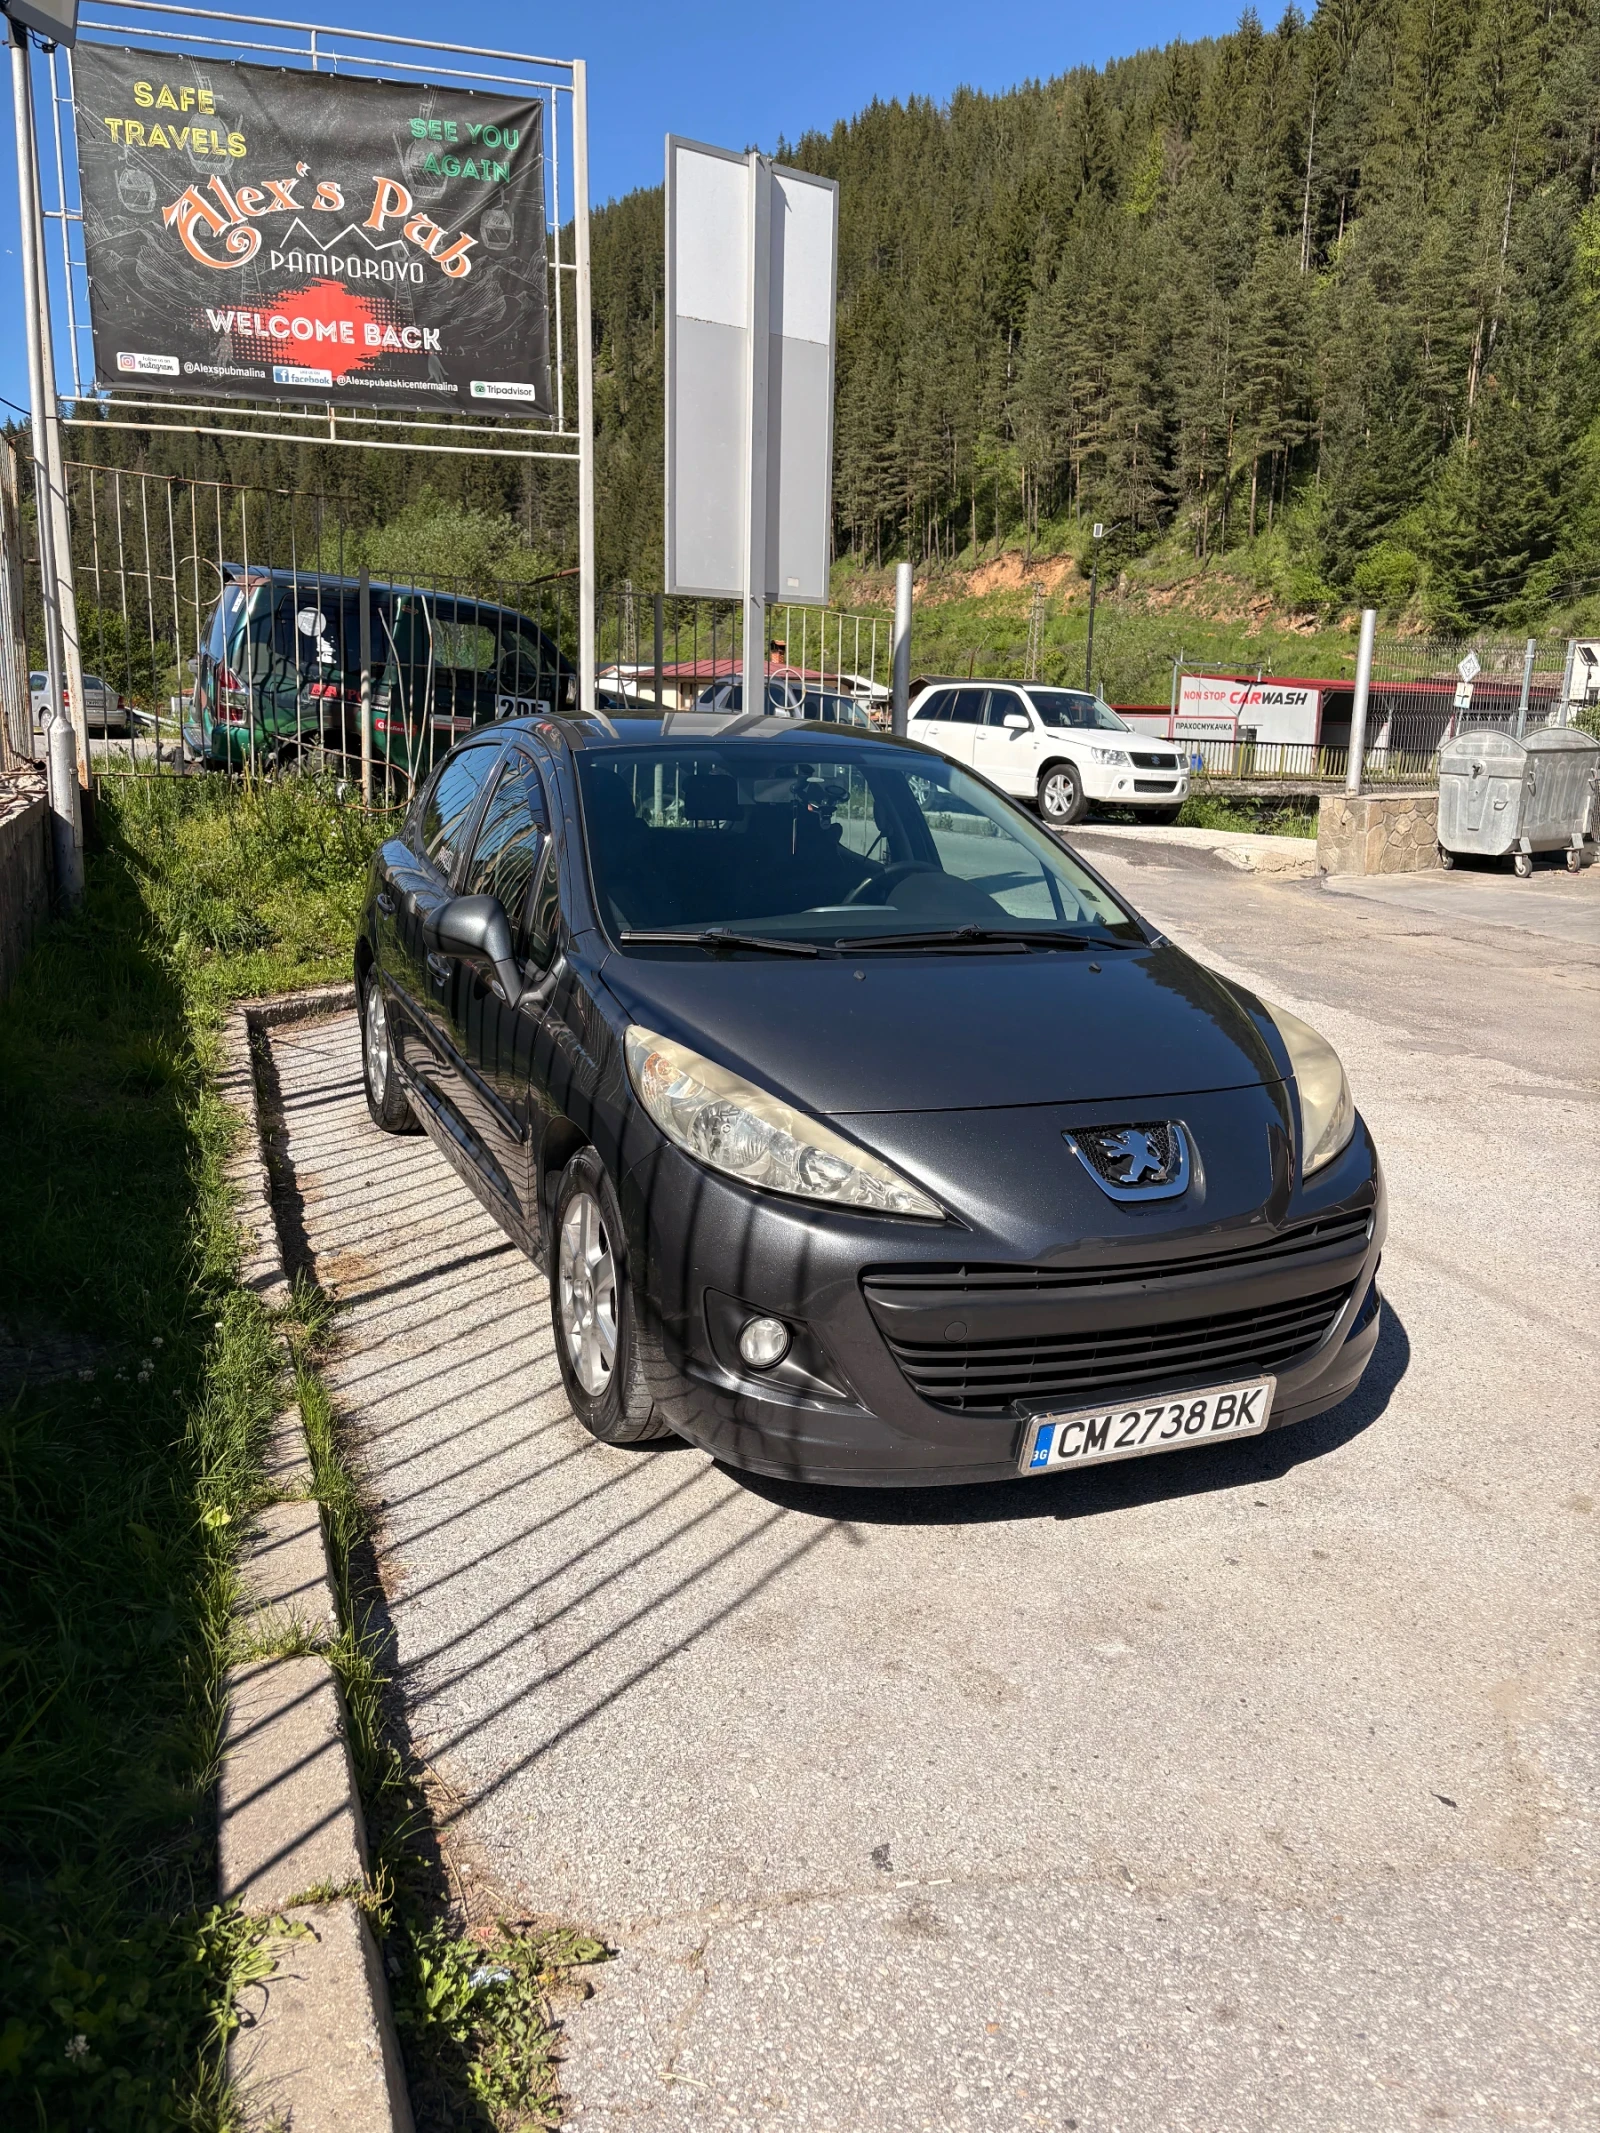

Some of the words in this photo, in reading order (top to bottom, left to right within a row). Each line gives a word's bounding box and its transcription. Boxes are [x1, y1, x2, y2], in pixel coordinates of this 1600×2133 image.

[133, 81, 215, 115] SAFE
[104, 117, 247, 158] TRAVELS
[410, 117, 459, 143] SEE
[464, 122, 520, 151] YOU
[423, 151, 510, 183] AGAIN
[162, 161, 345, 269] Alex's
[362, 176, 479, 278] Pub
[270, 250, 424, 283] PAMPOROVO
[206, 308, 355, 344] WELCOME
[363, 323, 442, 351] BACK
[138, 360, 174, 372] Instagram
[184, 361, 266, 379] @Alexspubmalina
[291, 373, 331, 385] facebook
[486, 384, 532, 397] Tripadvisor
[1184, 691, 1201, 700] NON
[1204, 691, 1226, 701] STOP
[1229, 691, 1308, 705] CARWASH
[1175, 722, 1233, 731] ПРАХОСМУКАЧКА
[1057, 1414, 1113, 1458] CM
[1114, 1400, 1207, 1448] 2738
[1211, 1388, 1263, 1431] BK
